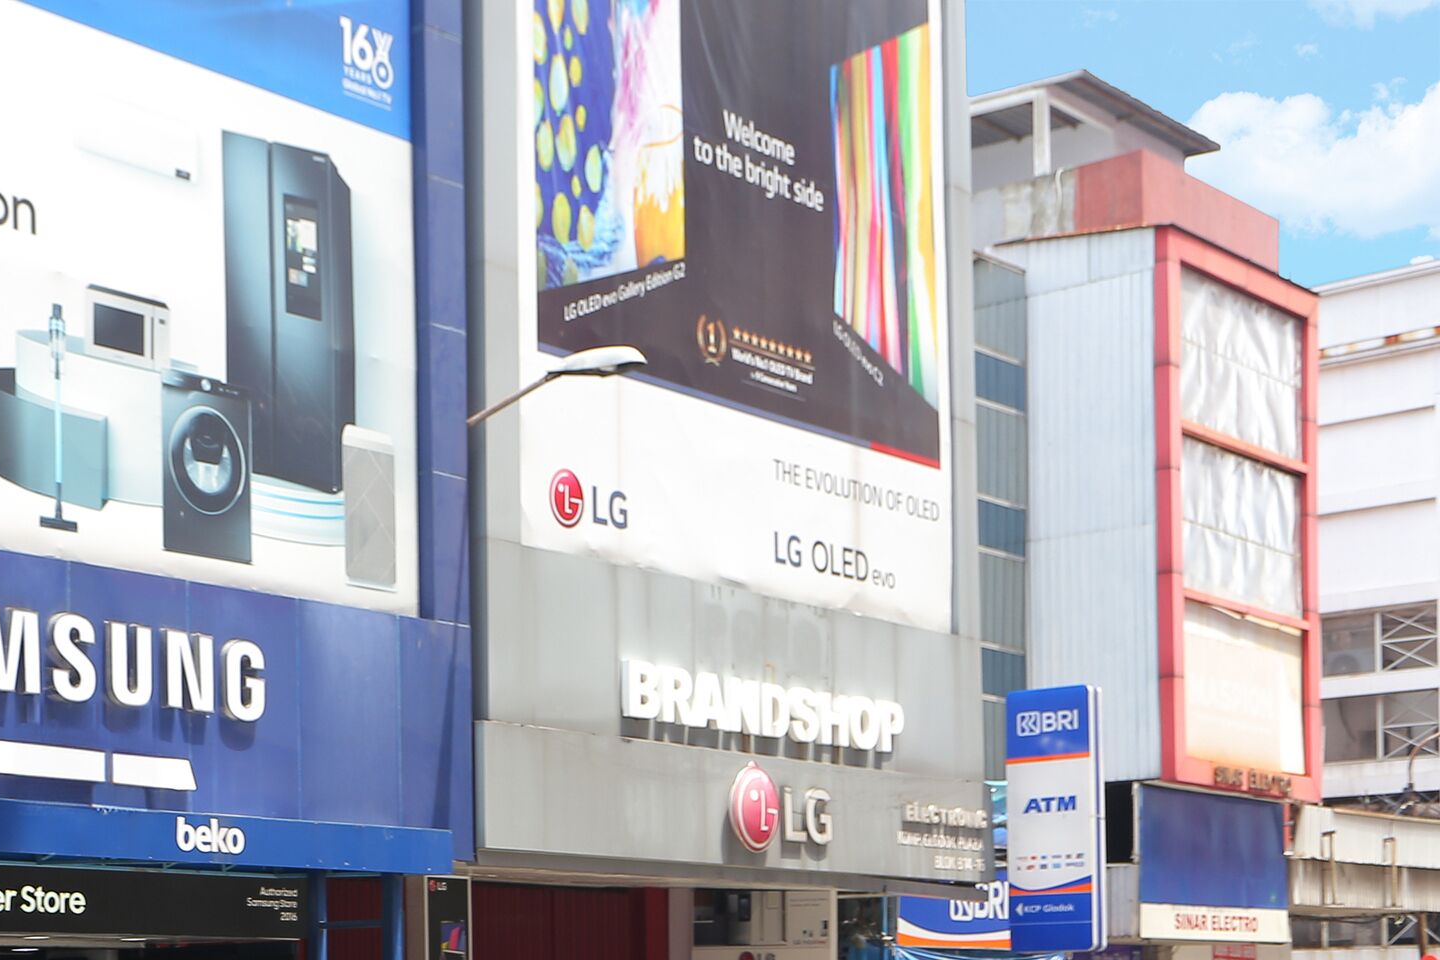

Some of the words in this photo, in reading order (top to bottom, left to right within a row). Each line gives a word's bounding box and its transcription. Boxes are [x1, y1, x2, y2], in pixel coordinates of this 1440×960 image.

[722, 108, 796, 167] Welcome
[692, 134, 714, 166] to
[715, 142, 743, 179] the
[744, 152, 792, 200] bright
[792, 178, 825, 213] side
[563, 302, 577, 322] LG
[576, 293, 602, 317] OLED
[591, 484, 629, 530] LG
[773, 458, 802, 488] THE
[805, 467, 883, 508] EVOLUTION
[885, 489, 904, 513] OF
[905, 495, 941, 522] OLED
[773, 530, 803, 569] LG
[811, 540, 869, 582] OLED
[871, 568, 896, 589] evo
[620, 659, 906, 753] BRANDSHOP
[1041, 708, 1079, 733] BRI
[781, 785, 834, 846] LG
[1023, 795, 1077, 815] ATM
[175, 815, 247, 856] beko
[20, 884, 87, 915] Store
[246, 897, 279, 910] Samsung
[279, 899, 298, 909] Store
[259, 886, 299, 898] Authorized
[1174, 912, 1208, 931] SINAR
[1211, 914, 1258, 933] ELECTRO
